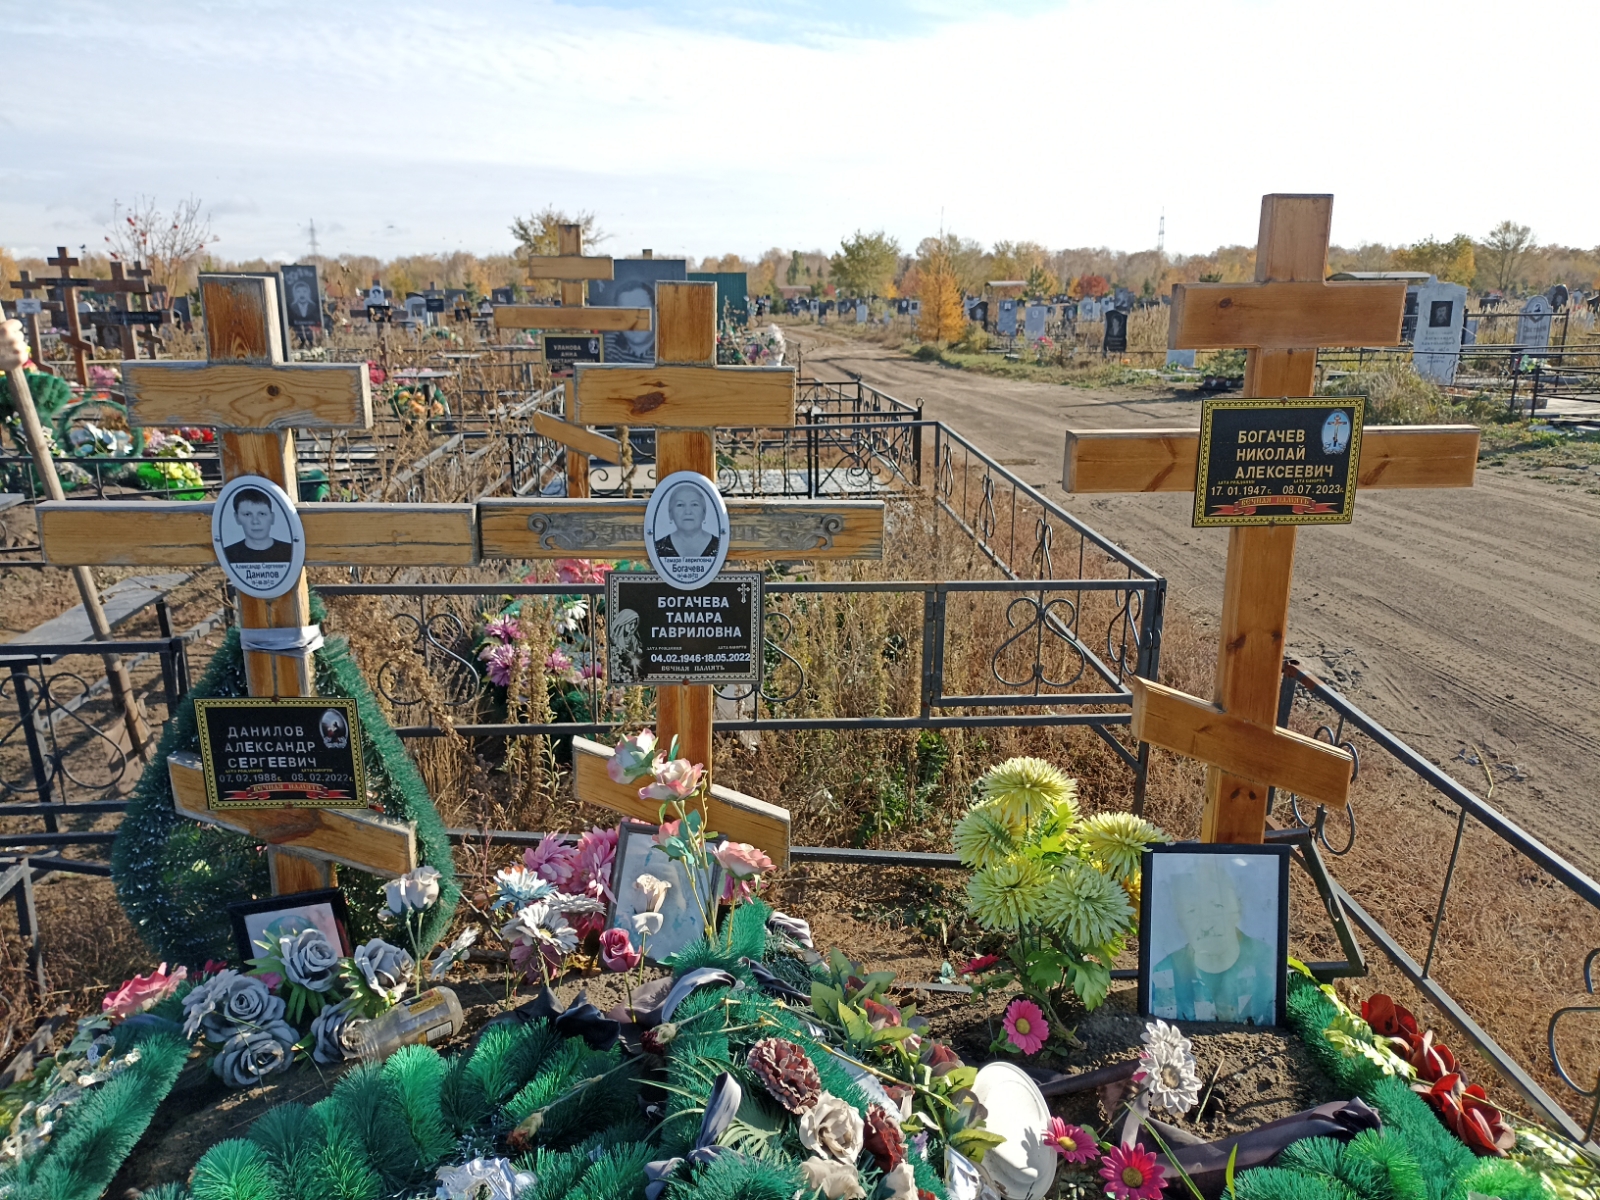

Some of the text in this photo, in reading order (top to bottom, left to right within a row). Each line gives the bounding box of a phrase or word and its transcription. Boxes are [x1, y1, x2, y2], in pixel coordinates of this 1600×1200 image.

[1237, 429, 1306, 444] БОГАЧЕВ
[1236, 445, 1306, 461] НИКОЛАЙ
[1234, 465, 1334, 479] АЛЕКСЕЕВИЧ
[672, 564, 705, 573] Богачева
[246, 570, 279, 580] Данилов
[657, 596, 729, 608] БОГАЧЕВА
[666, 612, 722, 623] ТАМАРА
[651, 627, 742, 638] ГАВРИЛОВНА
[228, 726, 304, 739] ДАНИЛОВ
[224, 742, 316, 753] АЛЕКСАНДР
[228, 757, 316, 768] СЕРГЕЕВИЧ
